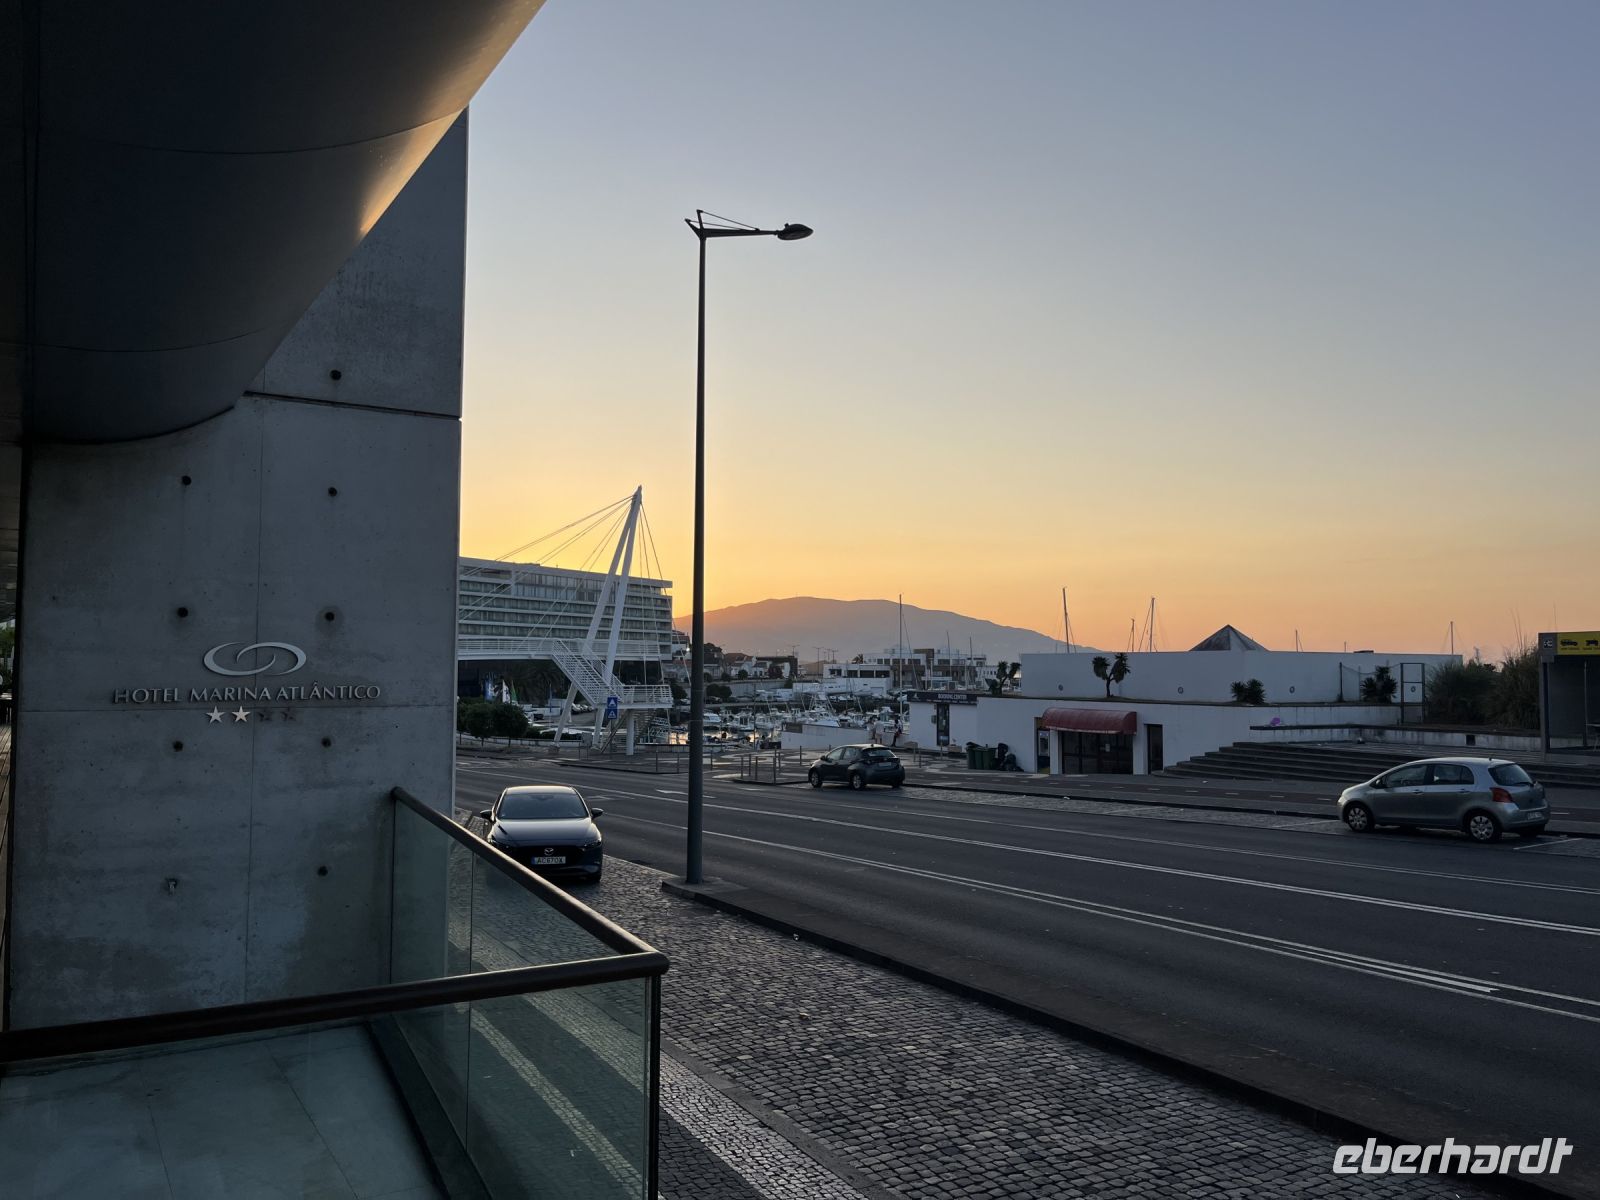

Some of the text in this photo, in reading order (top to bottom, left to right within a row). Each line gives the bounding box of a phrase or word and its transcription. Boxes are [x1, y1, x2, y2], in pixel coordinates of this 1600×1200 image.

[114, 681, 381, 703] HOTEL MARINA ATLÂNTICO
